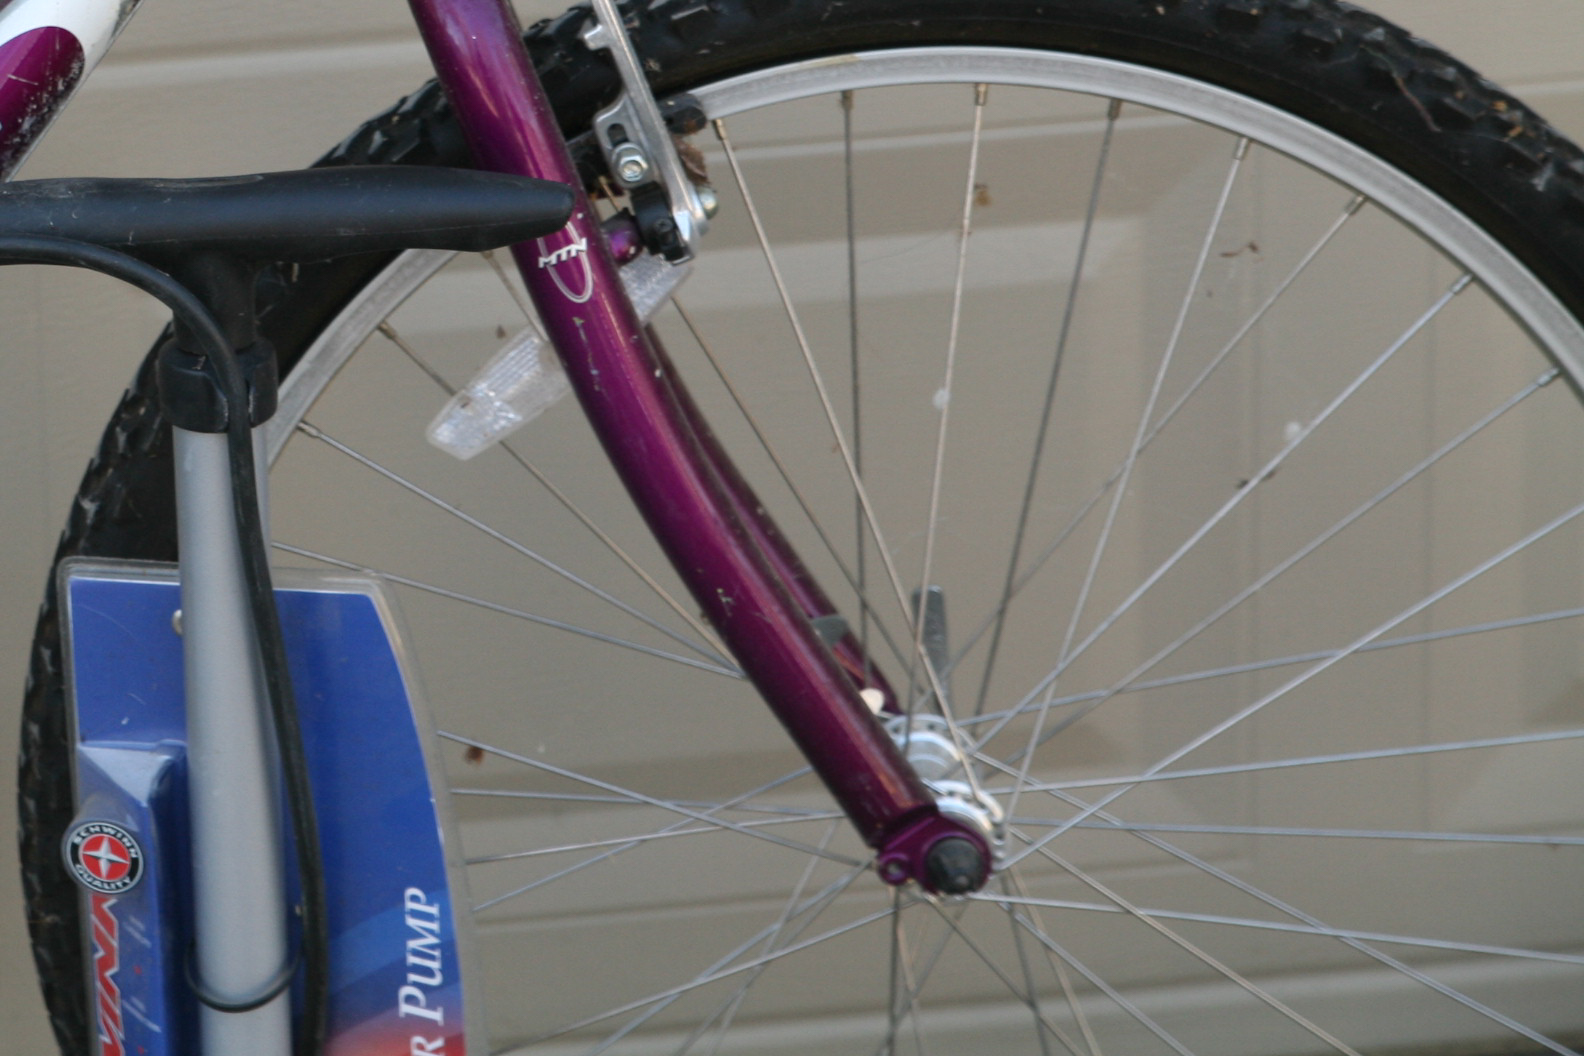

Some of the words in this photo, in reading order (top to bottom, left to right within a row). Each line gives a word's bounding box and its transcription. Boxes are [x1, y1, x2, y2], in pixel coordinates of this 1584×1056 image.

[73, 825, 139, 858] SCHWINN
[75, 863, 131, 890] QUALITY
[397, 886, 445, 1027] PUMP
